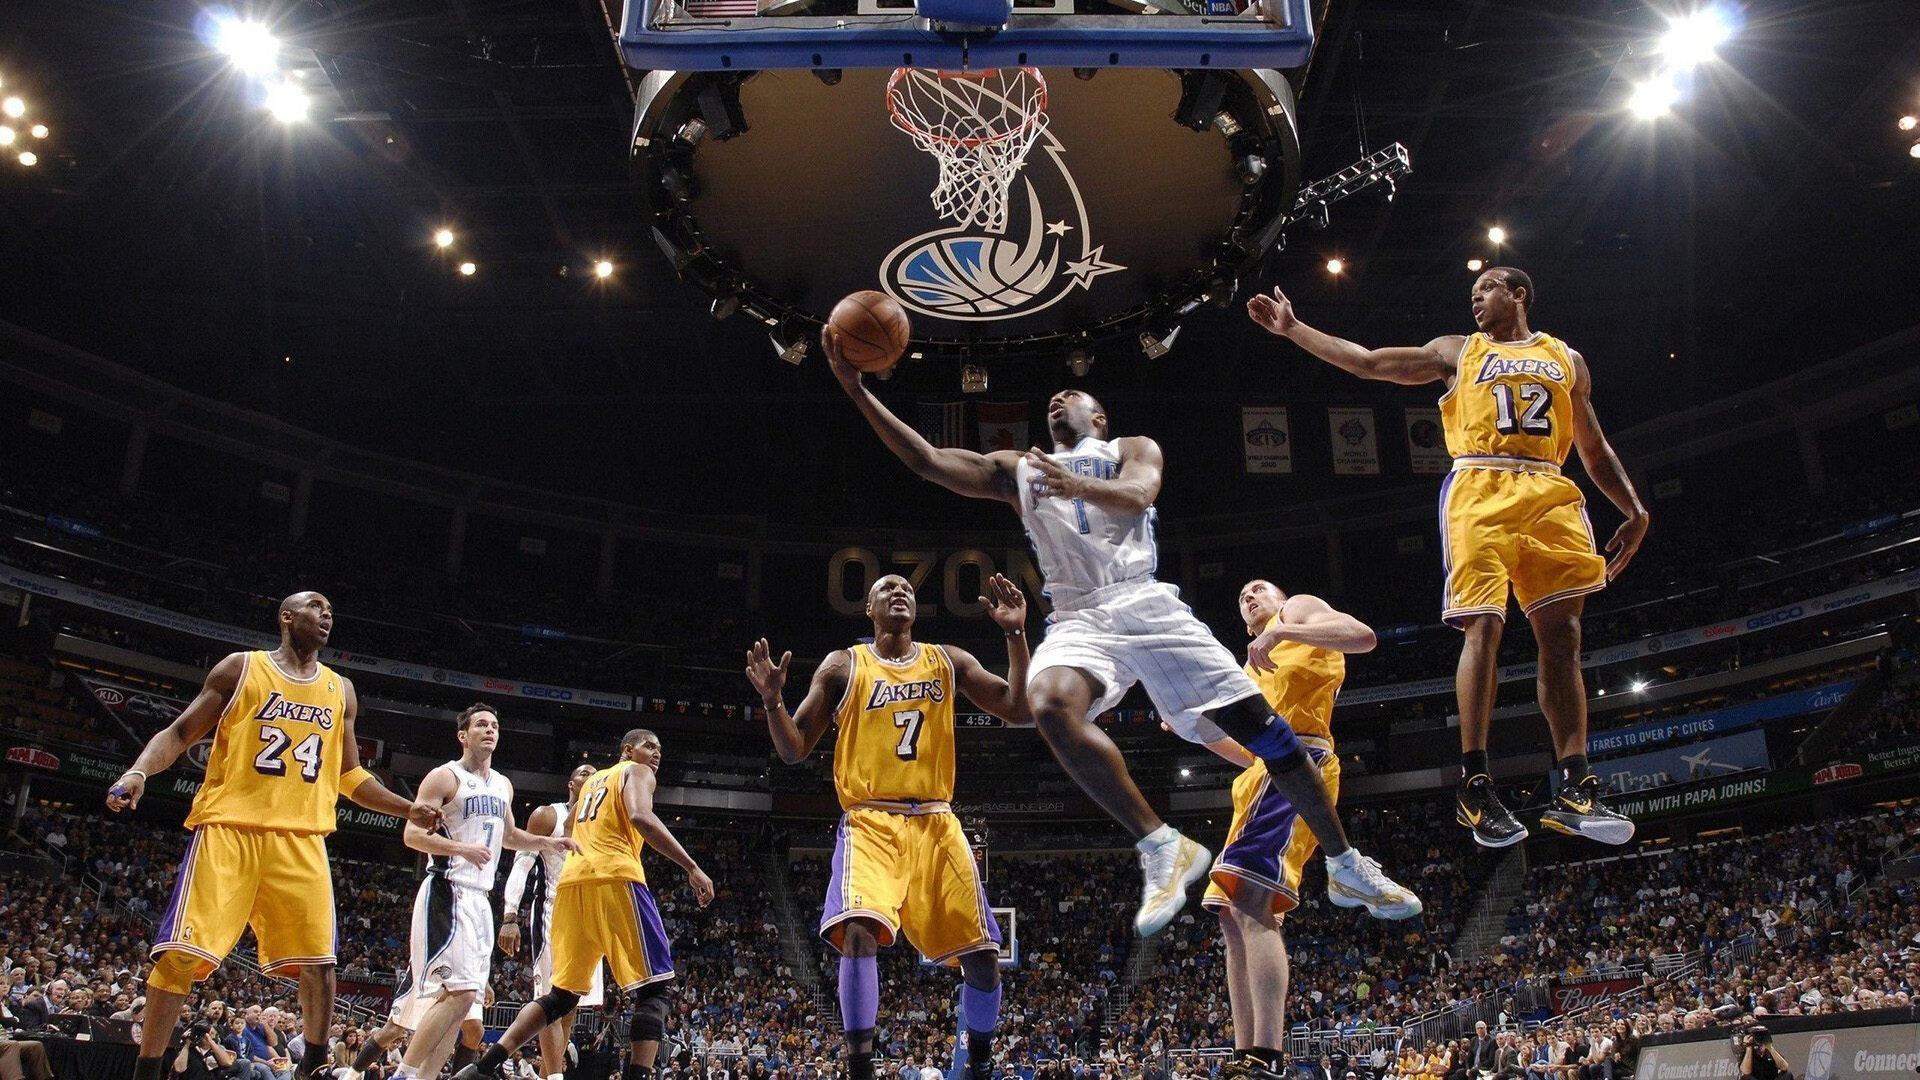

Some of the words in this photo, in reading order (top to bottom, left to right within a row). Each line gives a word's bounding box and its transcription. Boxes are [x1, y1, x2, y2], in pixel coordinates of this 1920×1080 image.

[1211, 3, 1233, 12] NBA
[1476, 353, 1565, 386] LAKERS
[1492, 383, 1553, 436] 12
[1072, 498, 1090, 534] 1
[1747, 605, 1803, 630] GEICO
[98, 690, 119, 702] KIA
[522, 684, 573, 700] GEICO
[866, 679, 944, 711] LAKERS
[254, 691, 334, 730] LAKERS
[589, 698, 627, 709] PEPSICO
[966, 716, 991, 726] 4:52
[1148, 710, 1155, 721] 4
[893, 709, 924, 761] 7
[1593, 735, 1622, 751] FARES
[1624, 733, 1636, 745] TO
[1639, 728, 1665, 743] OVER
[1682, 719, 1714, 735] CITIES
[70, 753, 96, 767] Better
[254, 726, 323, 783] 24
[1867, 750, 1896, 762] Better
[1883, 757, 1911, 769] Better
[80, 765, 107, 778] Better
[577, 787, 608, 822] 17
[1618, 800, 1645, 815] WIN
[1649, 794, 1681, 812] WITH
[1684, 787, 1716, 807] PAPA
[1720, 778, 1767, 800] JOHNS!
[355, 811, 400, 829] JOHNS!
[483, 822, 495, 848] 7
[1658, 1061, 1699, 1079] Connect
[1699, 1060, 1713, 1078] at
